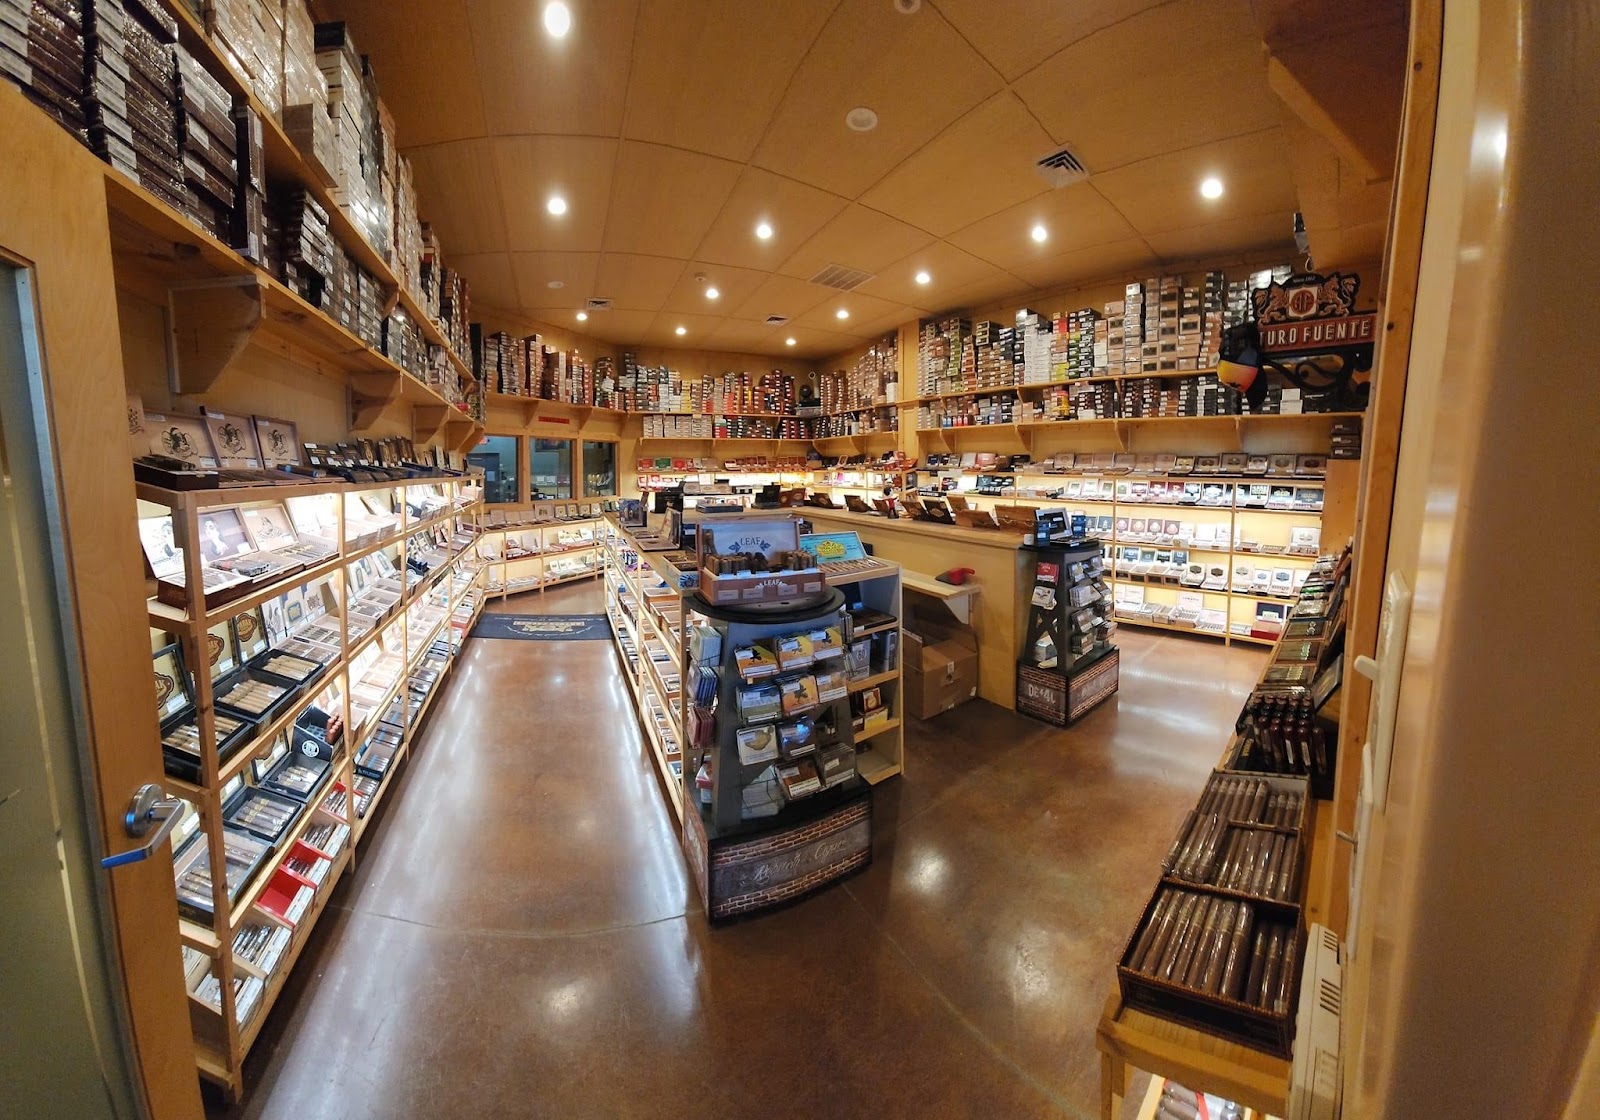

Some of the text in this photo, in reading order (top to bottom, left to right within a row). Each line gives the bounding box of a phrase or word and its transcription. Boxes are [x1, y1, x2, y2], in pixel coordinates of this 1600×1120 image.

[1303, 319, 1371, 342] FUENTE
[740, 536, 762, 547] LEAF
[763, 578, 780, 587] LEAF
